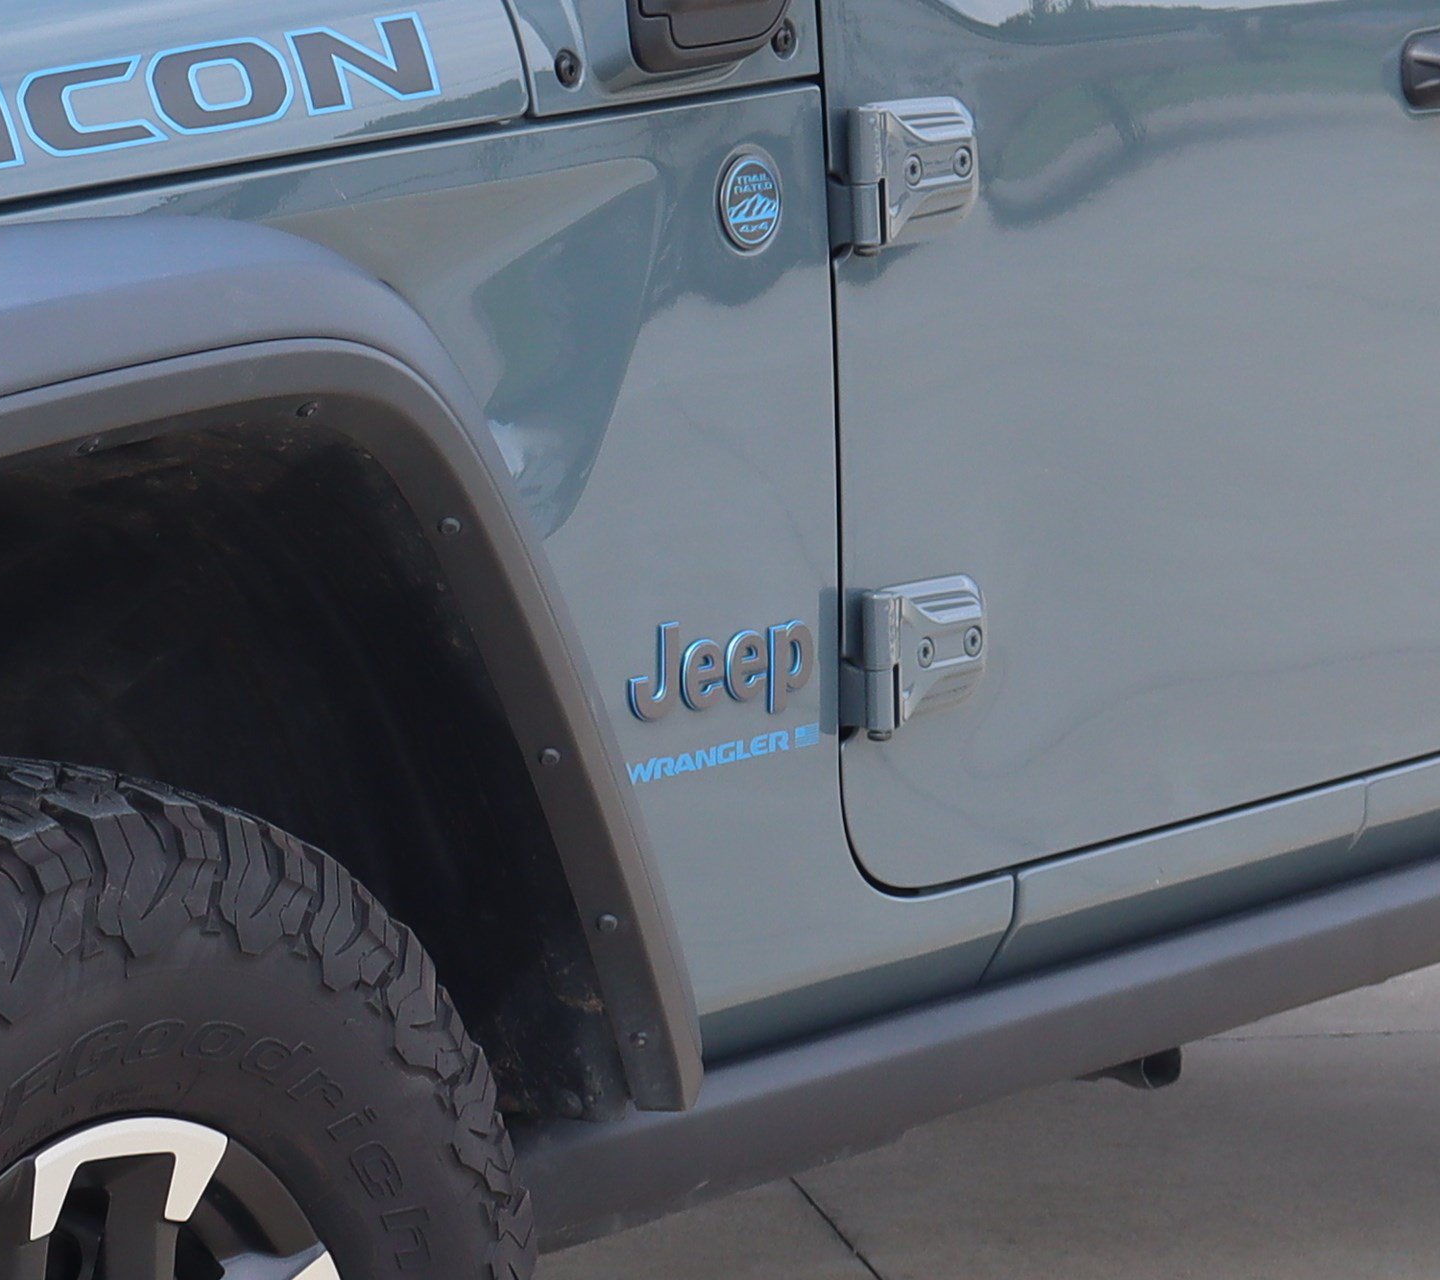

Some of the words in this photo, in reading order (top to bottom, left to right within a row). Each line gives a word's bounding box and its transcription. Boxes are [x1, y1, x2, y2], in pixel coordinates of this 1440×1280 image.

[733, 181, 773, 195] RATED
[736, 172, 769, 185] TRAIL
[627, 618, 815, 722] Jeep
[625, 729, 790, 786] WRANGLER
